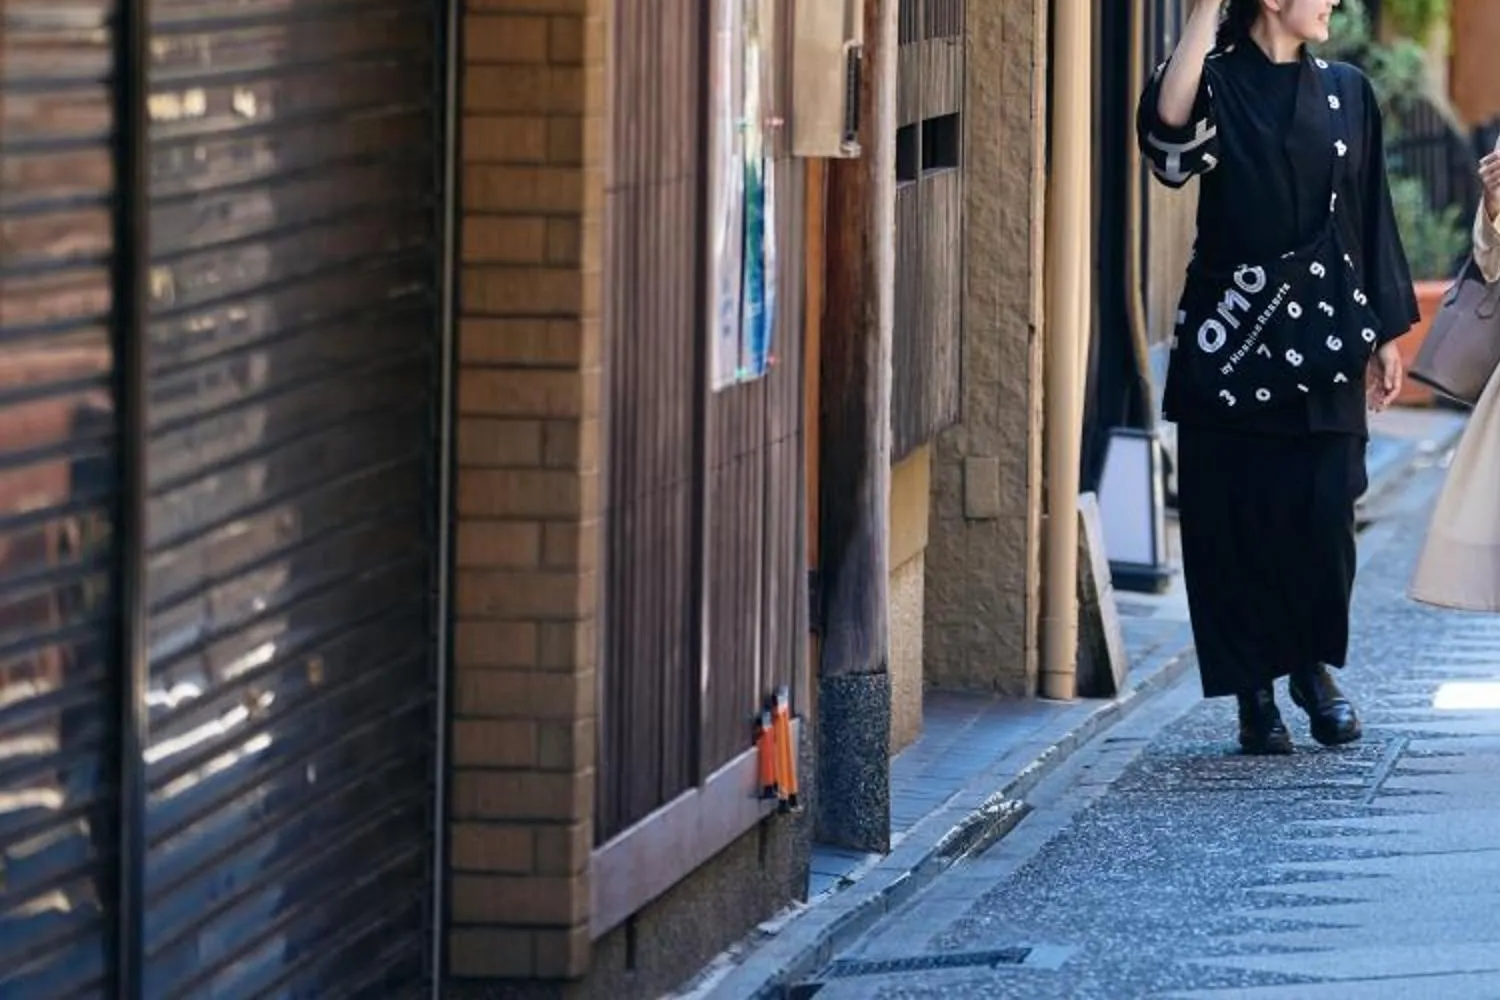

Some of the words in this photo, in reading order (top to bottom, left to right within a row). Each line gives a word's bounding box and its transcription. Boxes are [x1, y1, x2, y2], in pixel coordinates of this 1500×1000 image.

[1309, 261, 1326, 279] 9
[1197, 264, 1266, 353] OMO
[1287, 301, 1303, 319] 0
[1318, 301, 1335, 317] 3
[1325, 335, 1343, 351] 6
[1285, 348, 1304, 367] 8
[1219, 361, 1234, 375] by
[1219, 389, 1237, 407] 3
[1255, 388, 1271, 401] 0
